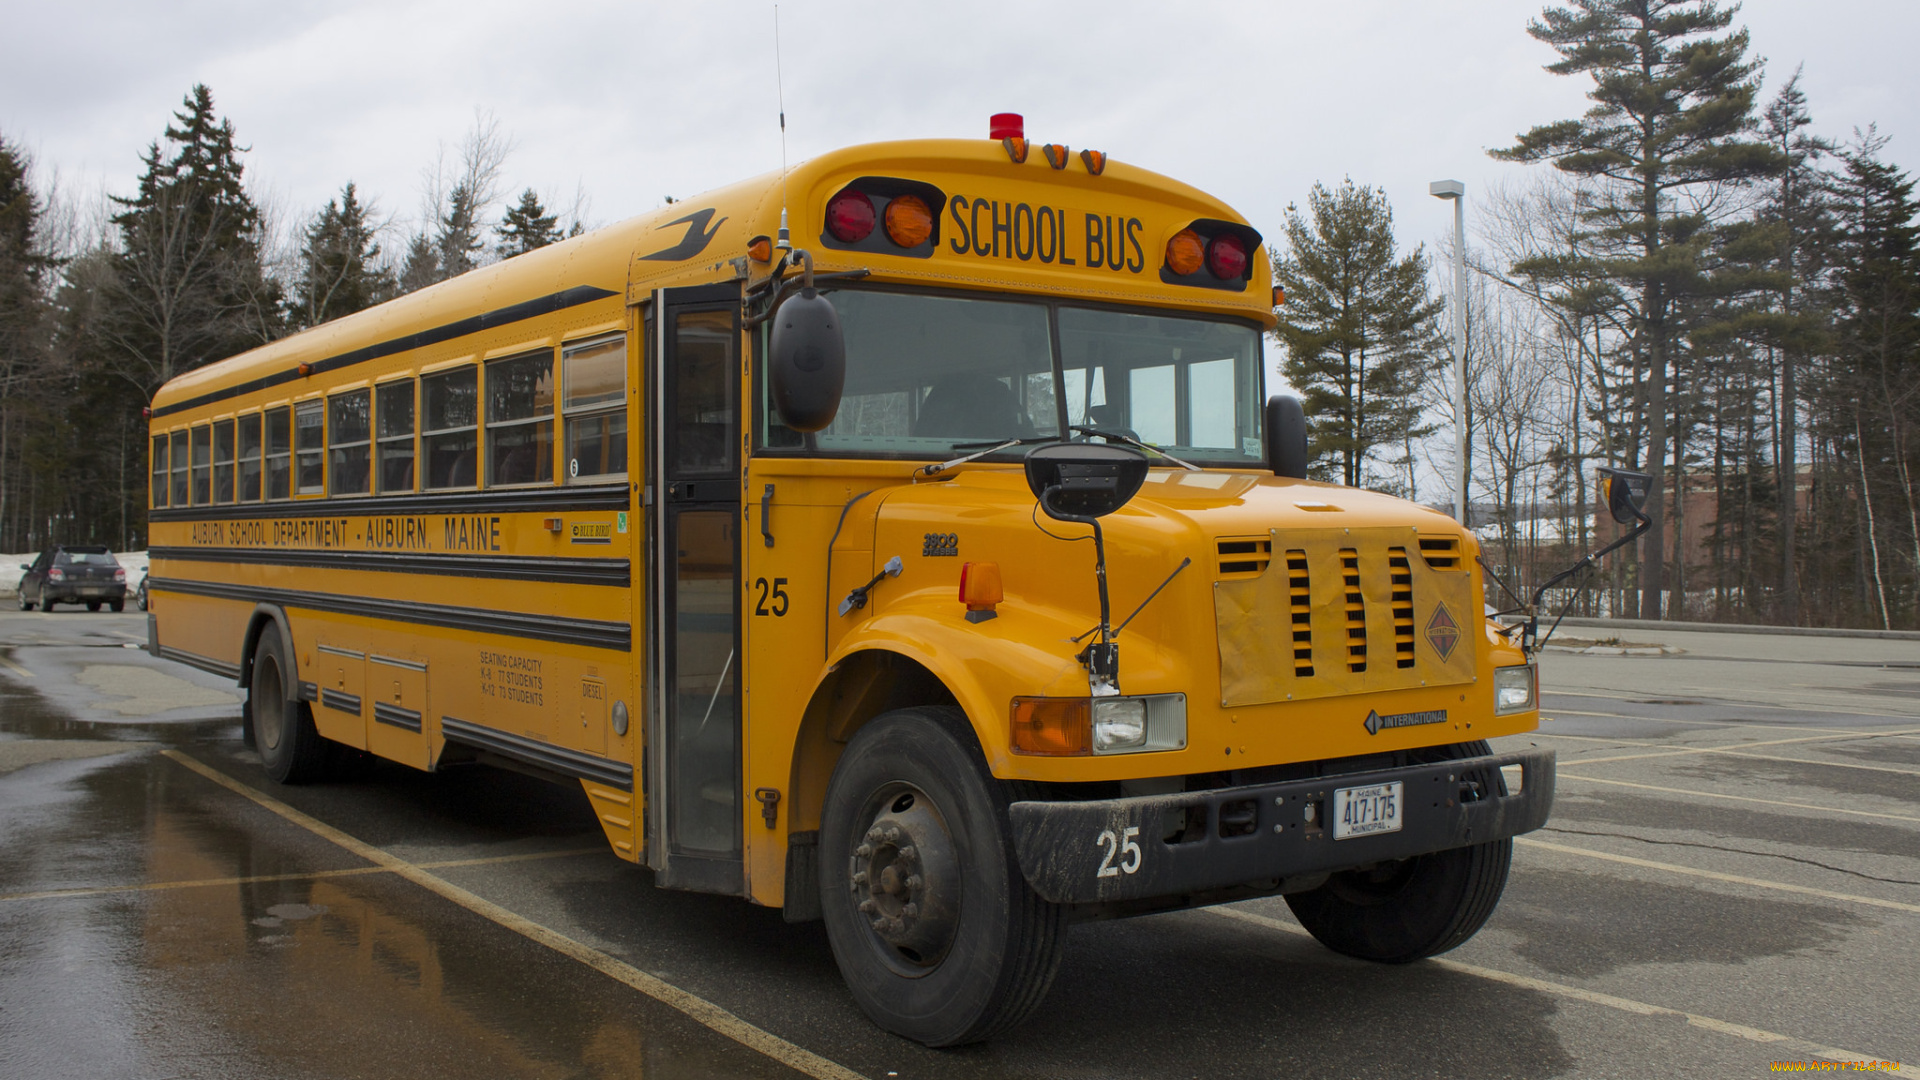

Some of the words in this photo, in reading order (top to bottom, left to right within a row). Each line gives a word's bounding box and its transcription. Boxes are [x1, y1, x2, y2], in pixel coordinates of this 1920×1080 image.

[949, 194, 1076, 266] SCHOOL
[1085, 213, 1145, 274] BUS
[192, 522, 224, 545] AUBURN
[229, 521, 267, 546] SCHOOL
[273, 520, 348, 547] DEPARTMENT
[444, 517, 500, 551] MAINE
[923, 532, 958, 548] 3800
[755, 577, 789, 617] 25
[480, 651, 507, 668] SEATING
[508, 655, 542, 673] CAPACITY
[506, 671, 543, 690] STUDENTS
[481, 682, 495, 697] K-12
[508, 687, 543, 707] STUDENTS
[582, 683, 603, 700] DIESEL
[1384, 710, 1447, 728] INTERNATIONAL
[1357, 788, 1381, 797] MAINE
[1351, 822, 1386, 834] MUNICIPAL
[1096, 826, 1142, 878] 25
